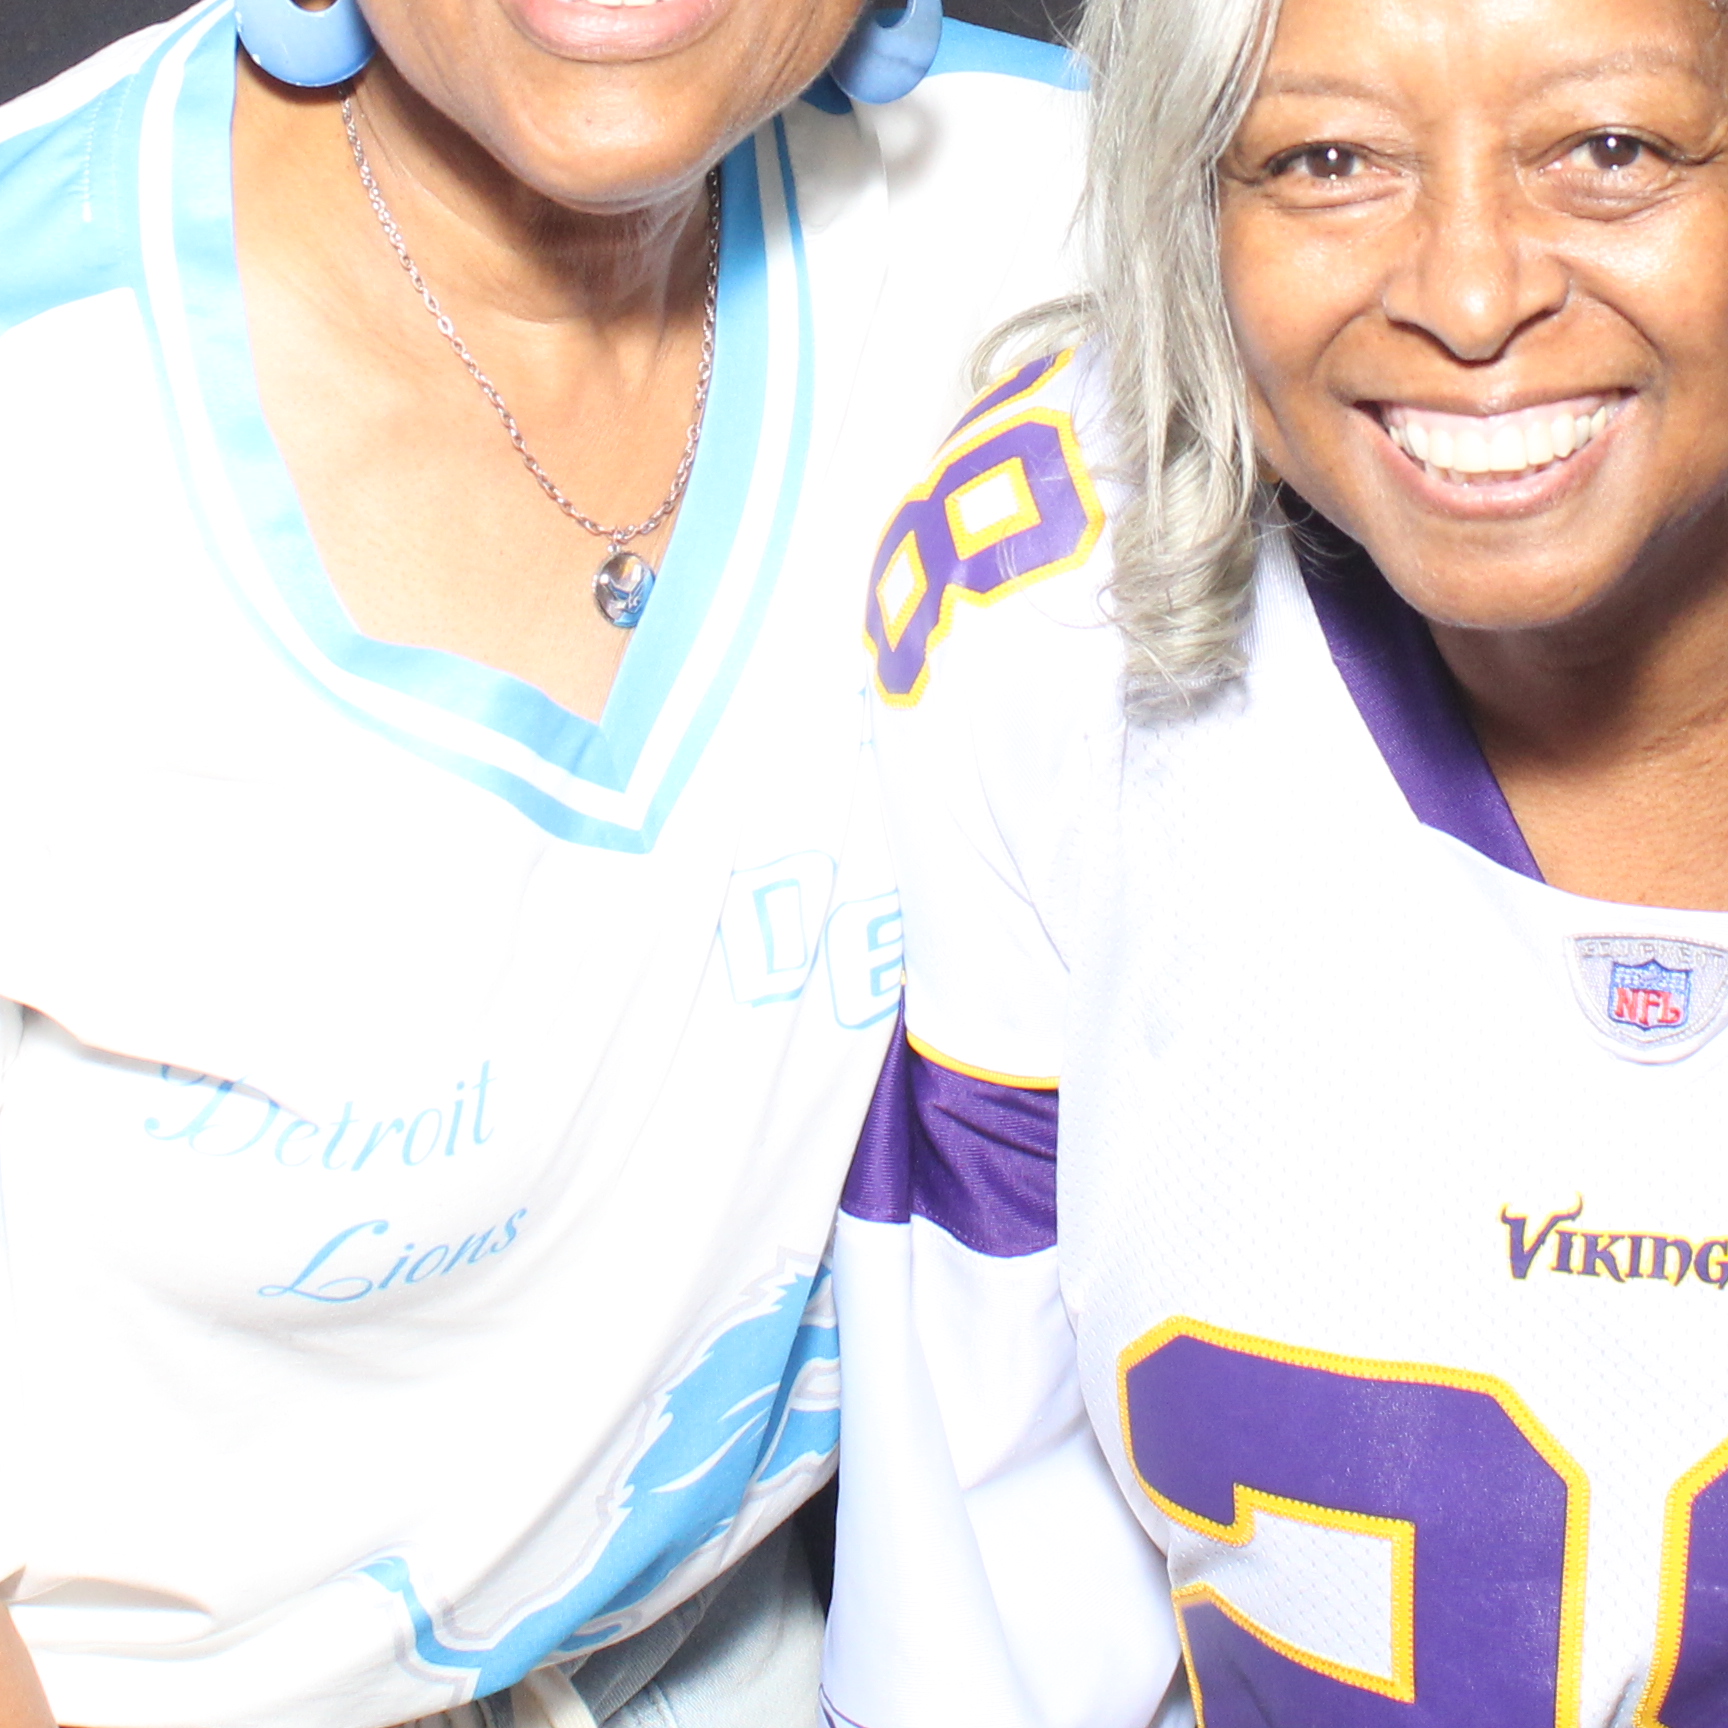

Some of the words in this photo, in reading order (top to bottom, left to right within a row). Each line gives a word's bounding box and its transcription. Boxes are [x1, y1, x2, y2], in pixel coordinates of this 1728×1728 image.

[1614, 985, 1683, 1026] NFL
[144, 1059, 498, 1172] Detroit
[256, 1207, 528, 1303] Lions
